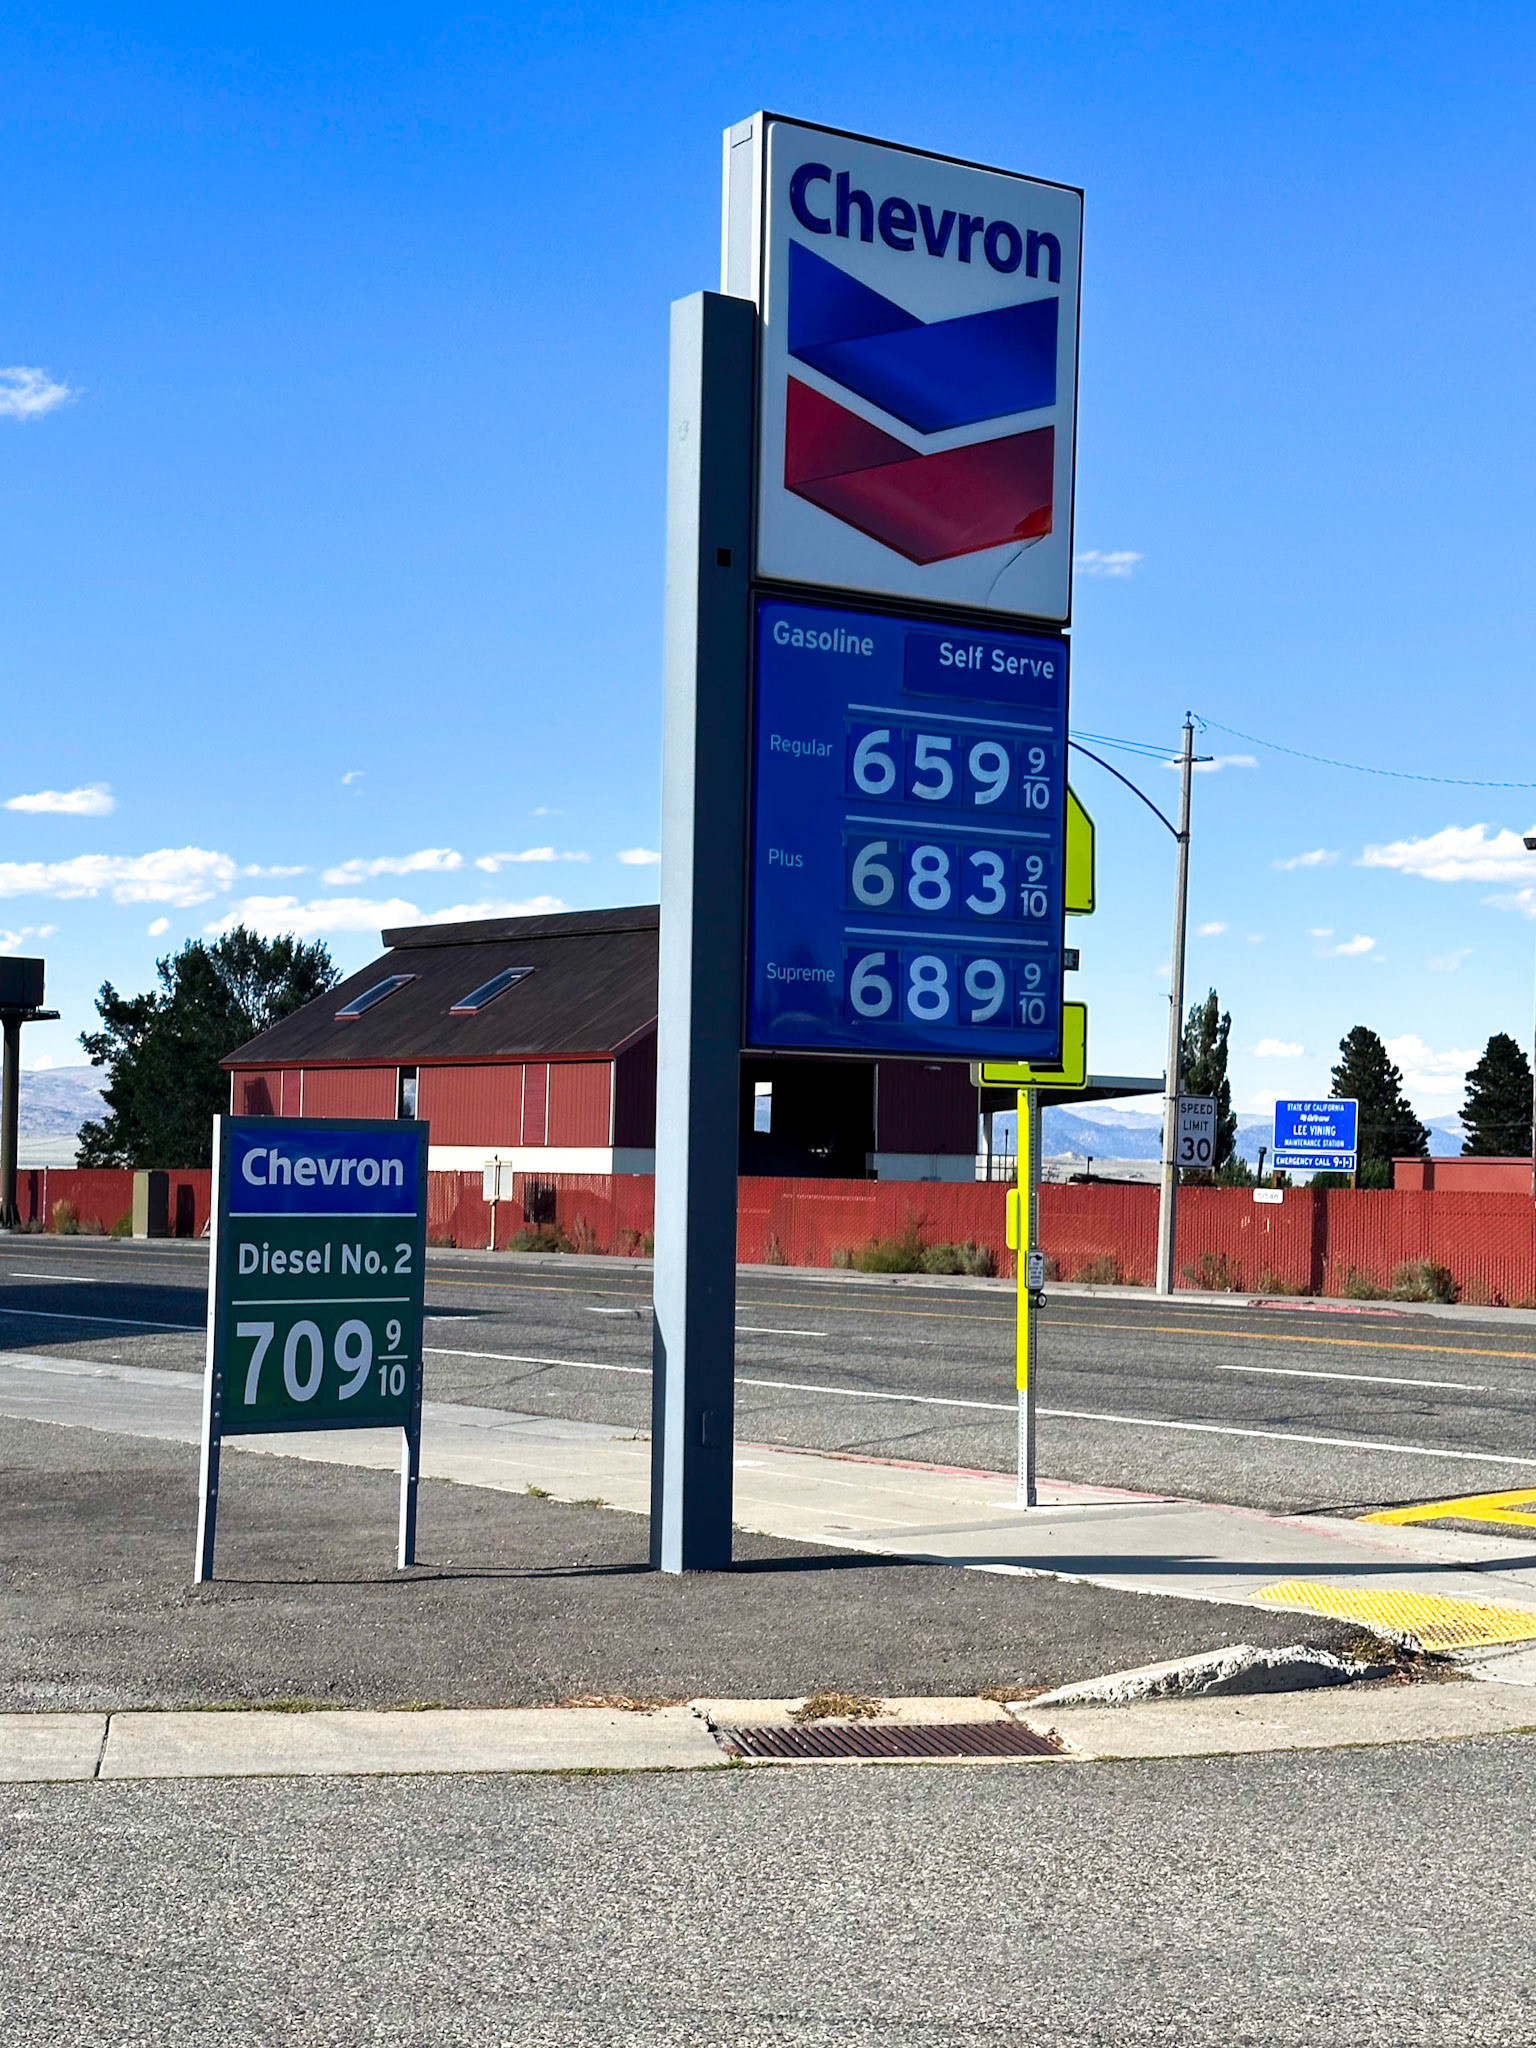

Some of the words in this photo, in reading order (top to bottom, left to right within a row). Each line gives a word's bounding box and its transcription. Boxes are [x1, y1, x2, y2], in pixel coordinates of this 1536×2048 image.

[789, 161, 1061, 284] Chevron
[773, 620, 874, 657] Gasoline
[939, 641, 983, 671] Self
[991, 649, 1055, 679] Serve
[770, 734, 833, 759] Regular
[853, 729, 1011, 806] 659
[768, 848, 804, 868] Plus
[851, 840, 1006, 916] 683
[766, 962, 836, 985] Supreme
[849, 952, 1006, 1023] 689
[1180, 1102, 1213, 1115] SPEED
[1287, 1103, 1302, 1111] STATE
[1304, 1103, 1311, 1111] OF
[1313, 1103, 1344, 1112] CALIFORNIA
[1183, 1119, 1209, 1132] LIMIT
[1293, 1125, 1308, 1136] LEE
[1310, 1125, 1336, 1137] VINING
[1180, 1136, 1211, 1162] 30
[1276, 1156, 1313, 1166] EMERGENCY
[1314, 1157, 1331, 1166] CALL
[1284, 1139, 1321, 1147] MAINTENANCE
[1323, 1139, 1345, 1148] STATION
[241, 1147, 404, 1187] Chevron
[238, 1242, 331, 1275] Diesel
[236, 1319, 373, 1405] 709
